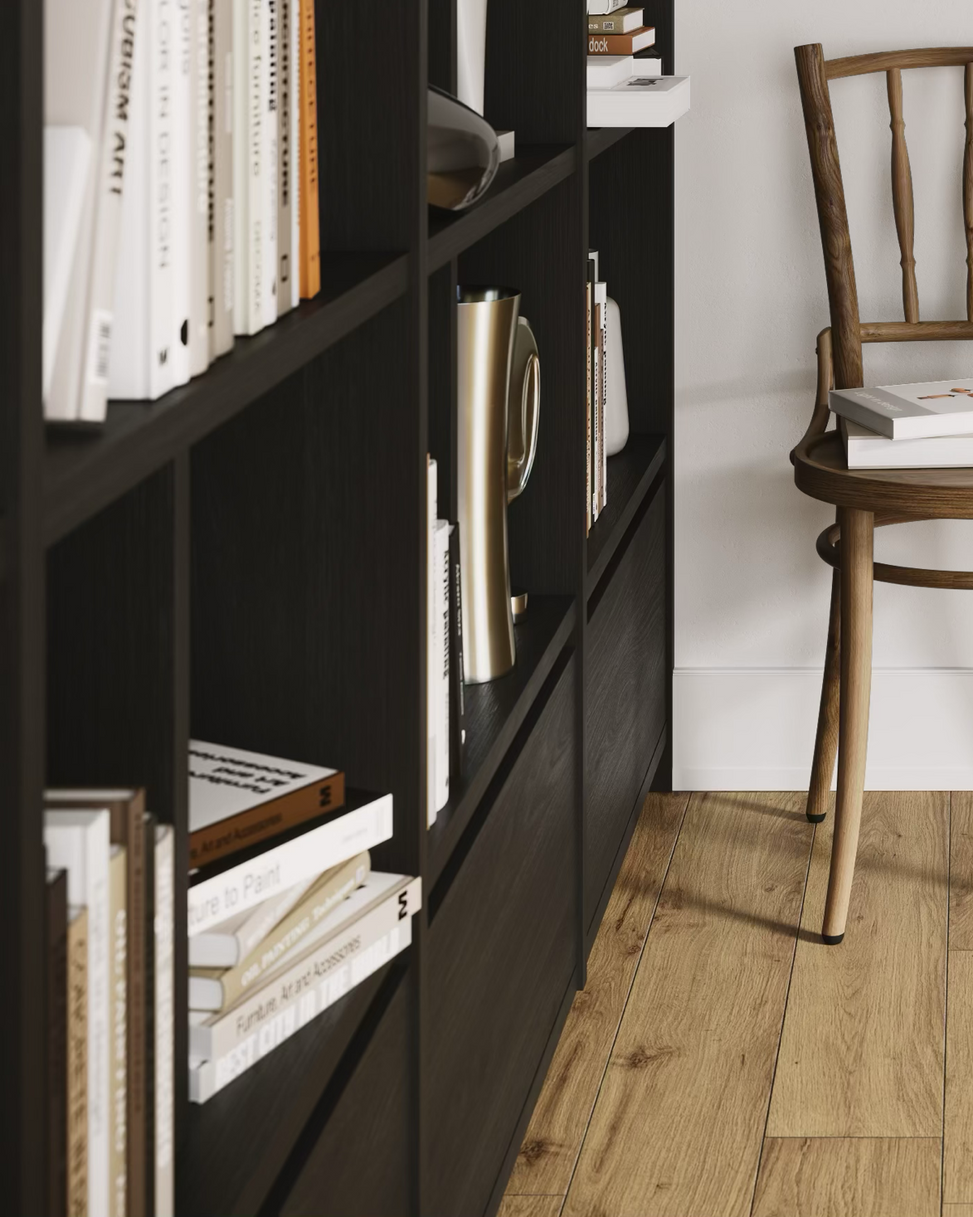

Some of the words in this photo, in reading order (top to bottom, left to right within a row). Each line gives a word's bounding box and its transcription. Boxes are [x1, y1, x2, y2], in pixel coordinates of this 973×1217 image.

[268, 0, 278, 113] painting
[588, 37, 609, 53] dock
[109, 130, 127, 199] ART
[224, 885, 239, 909] to
[243, 863, 281, 900] Paint
